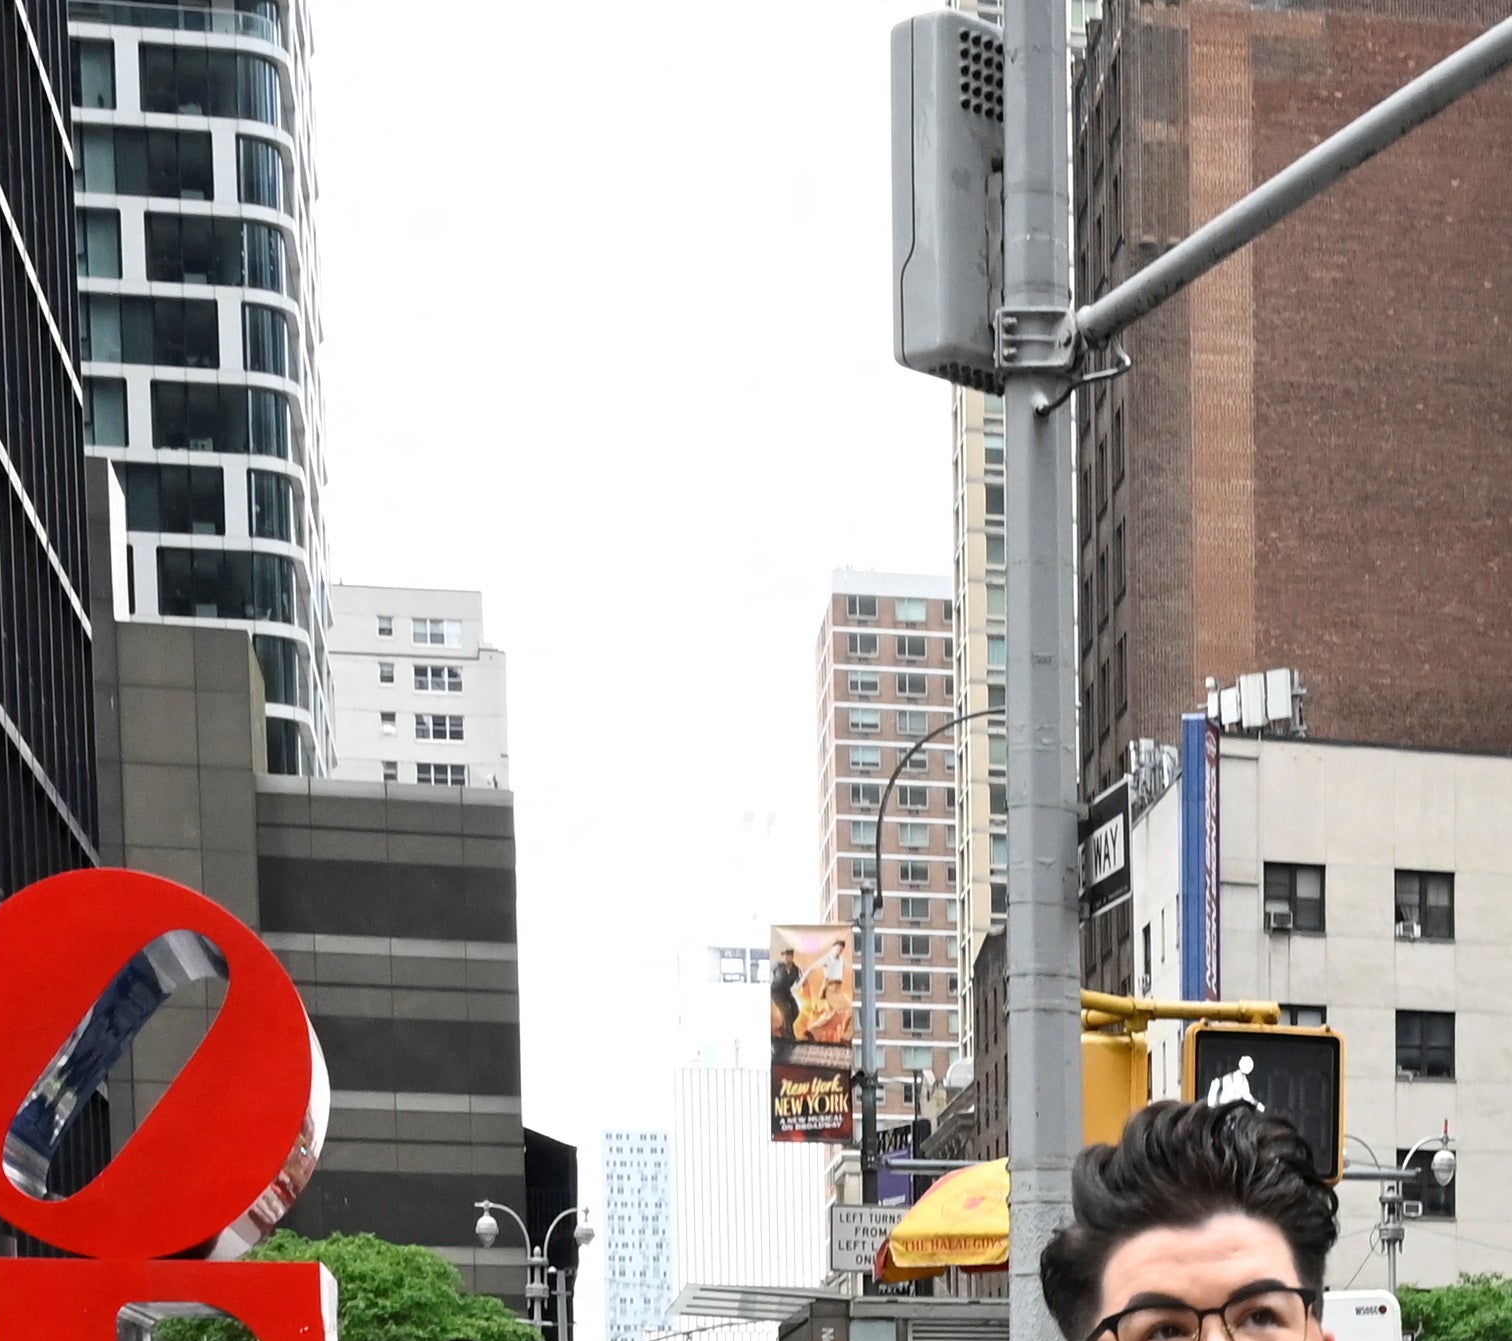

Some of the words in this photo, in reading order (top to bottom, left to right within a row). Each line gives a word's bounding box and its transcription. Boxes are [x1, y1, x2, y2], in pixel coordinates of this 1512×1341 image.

[1093, 823, 1119, 877] WAY
[780, 1078, 810, 1097] New
[811, 1073, 843, 1099] York
[775, 1095, 803, 1117] NEW
[806, 1093, 848, 1115] YORK
[839, 1213, 863, 1224] LEFT
[869, 1213, 902, 1224] TURNS
[854, 1226, 887, 1238] FROM
[838, 1240, 866, 1251] LEFT
[903, 1239, 927, 1253] THE
[931, 1238, 970, 1251] HALAL
